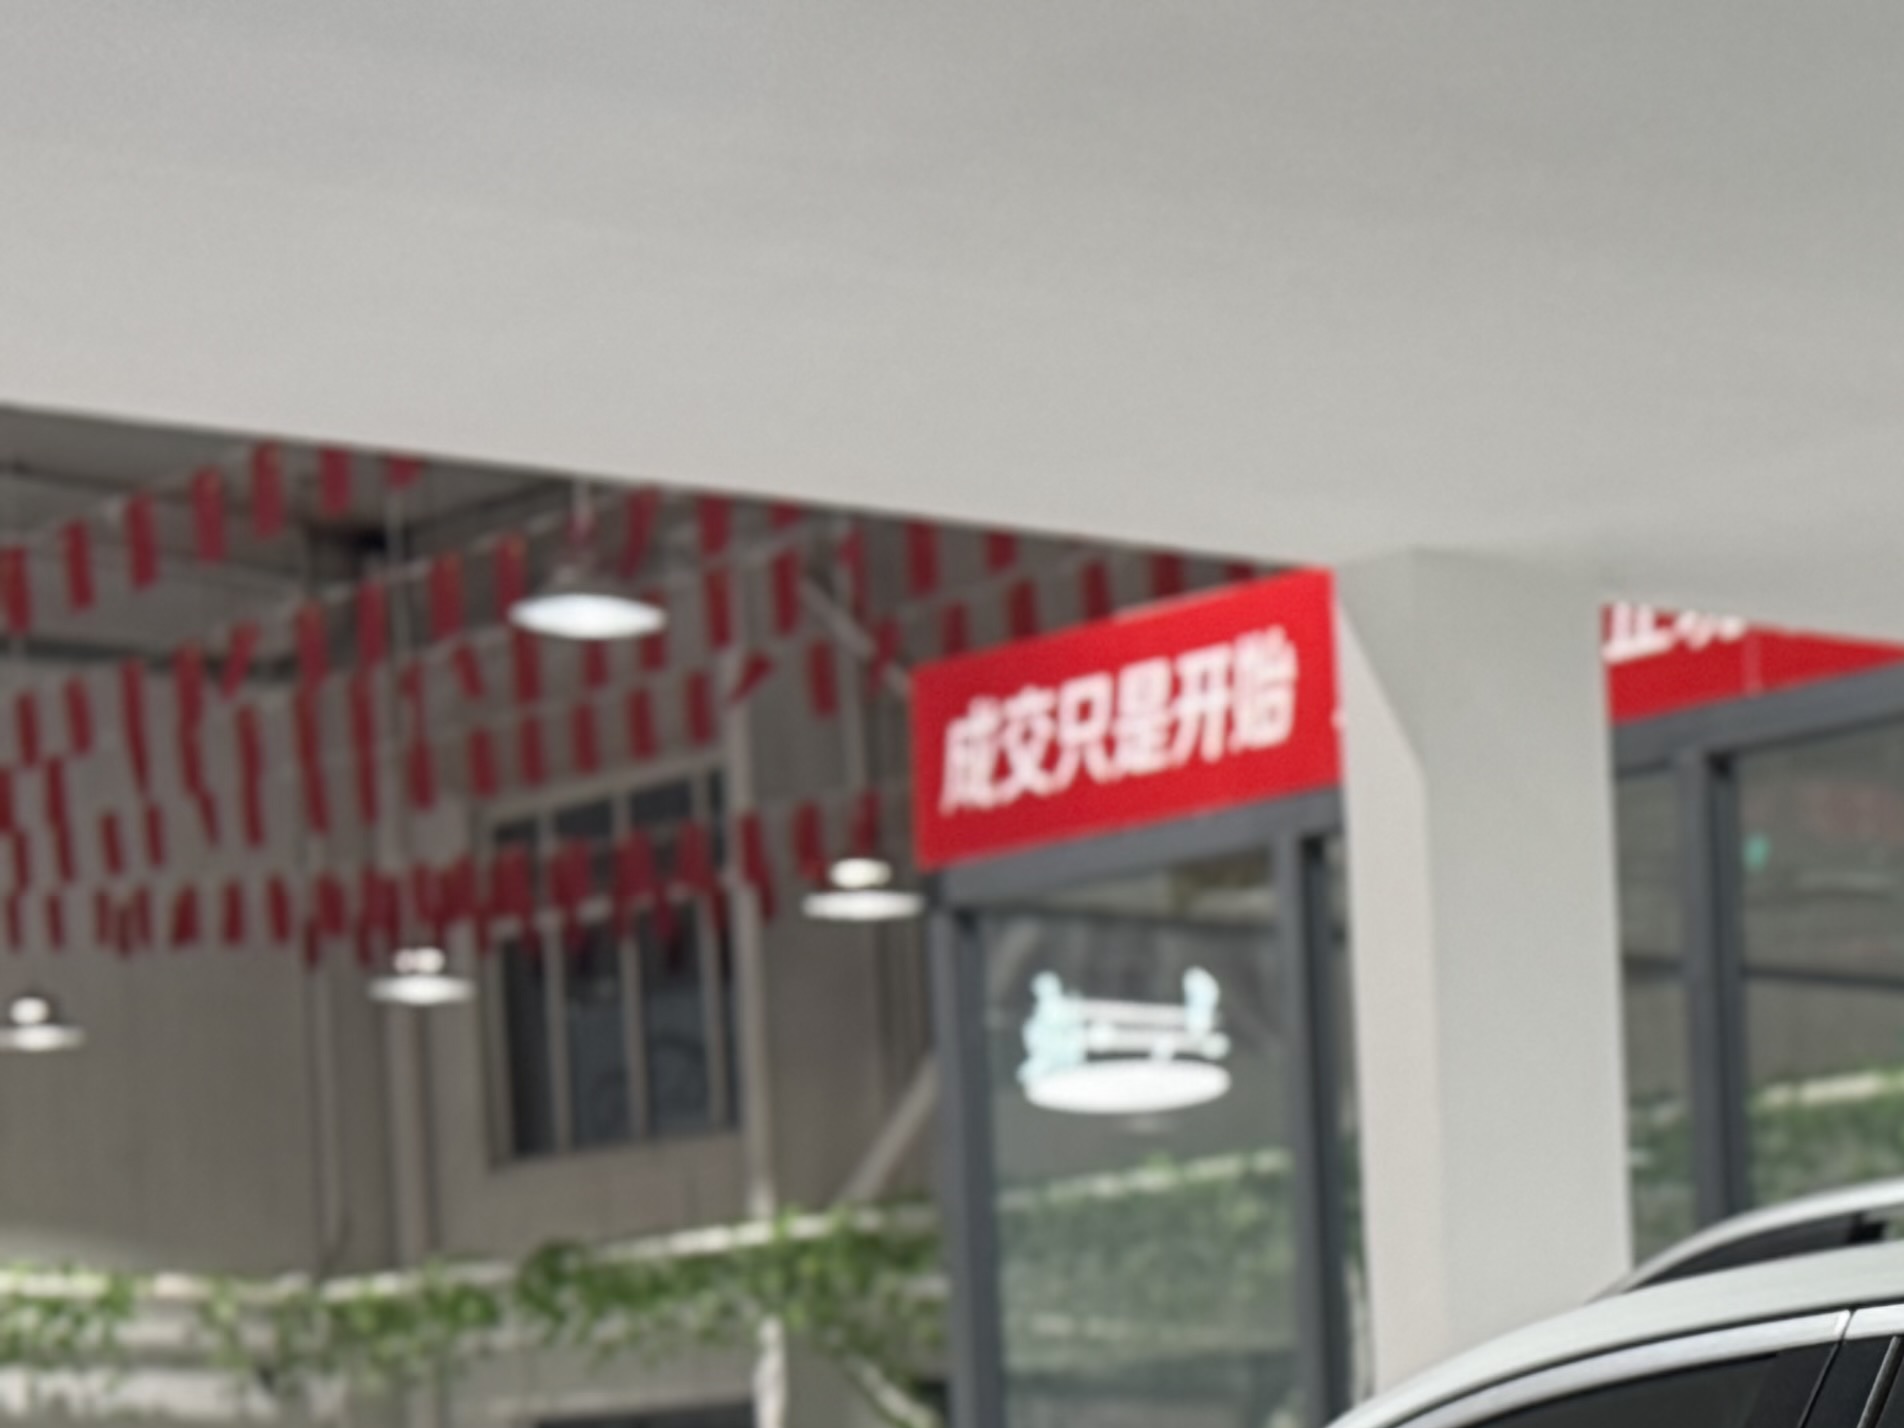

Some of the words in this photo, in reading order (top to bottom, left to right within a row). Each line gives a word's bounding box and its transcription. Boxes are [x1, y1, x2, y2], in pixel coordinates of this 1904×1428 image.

[939, 624, 1298, 817] 成交只是开始
